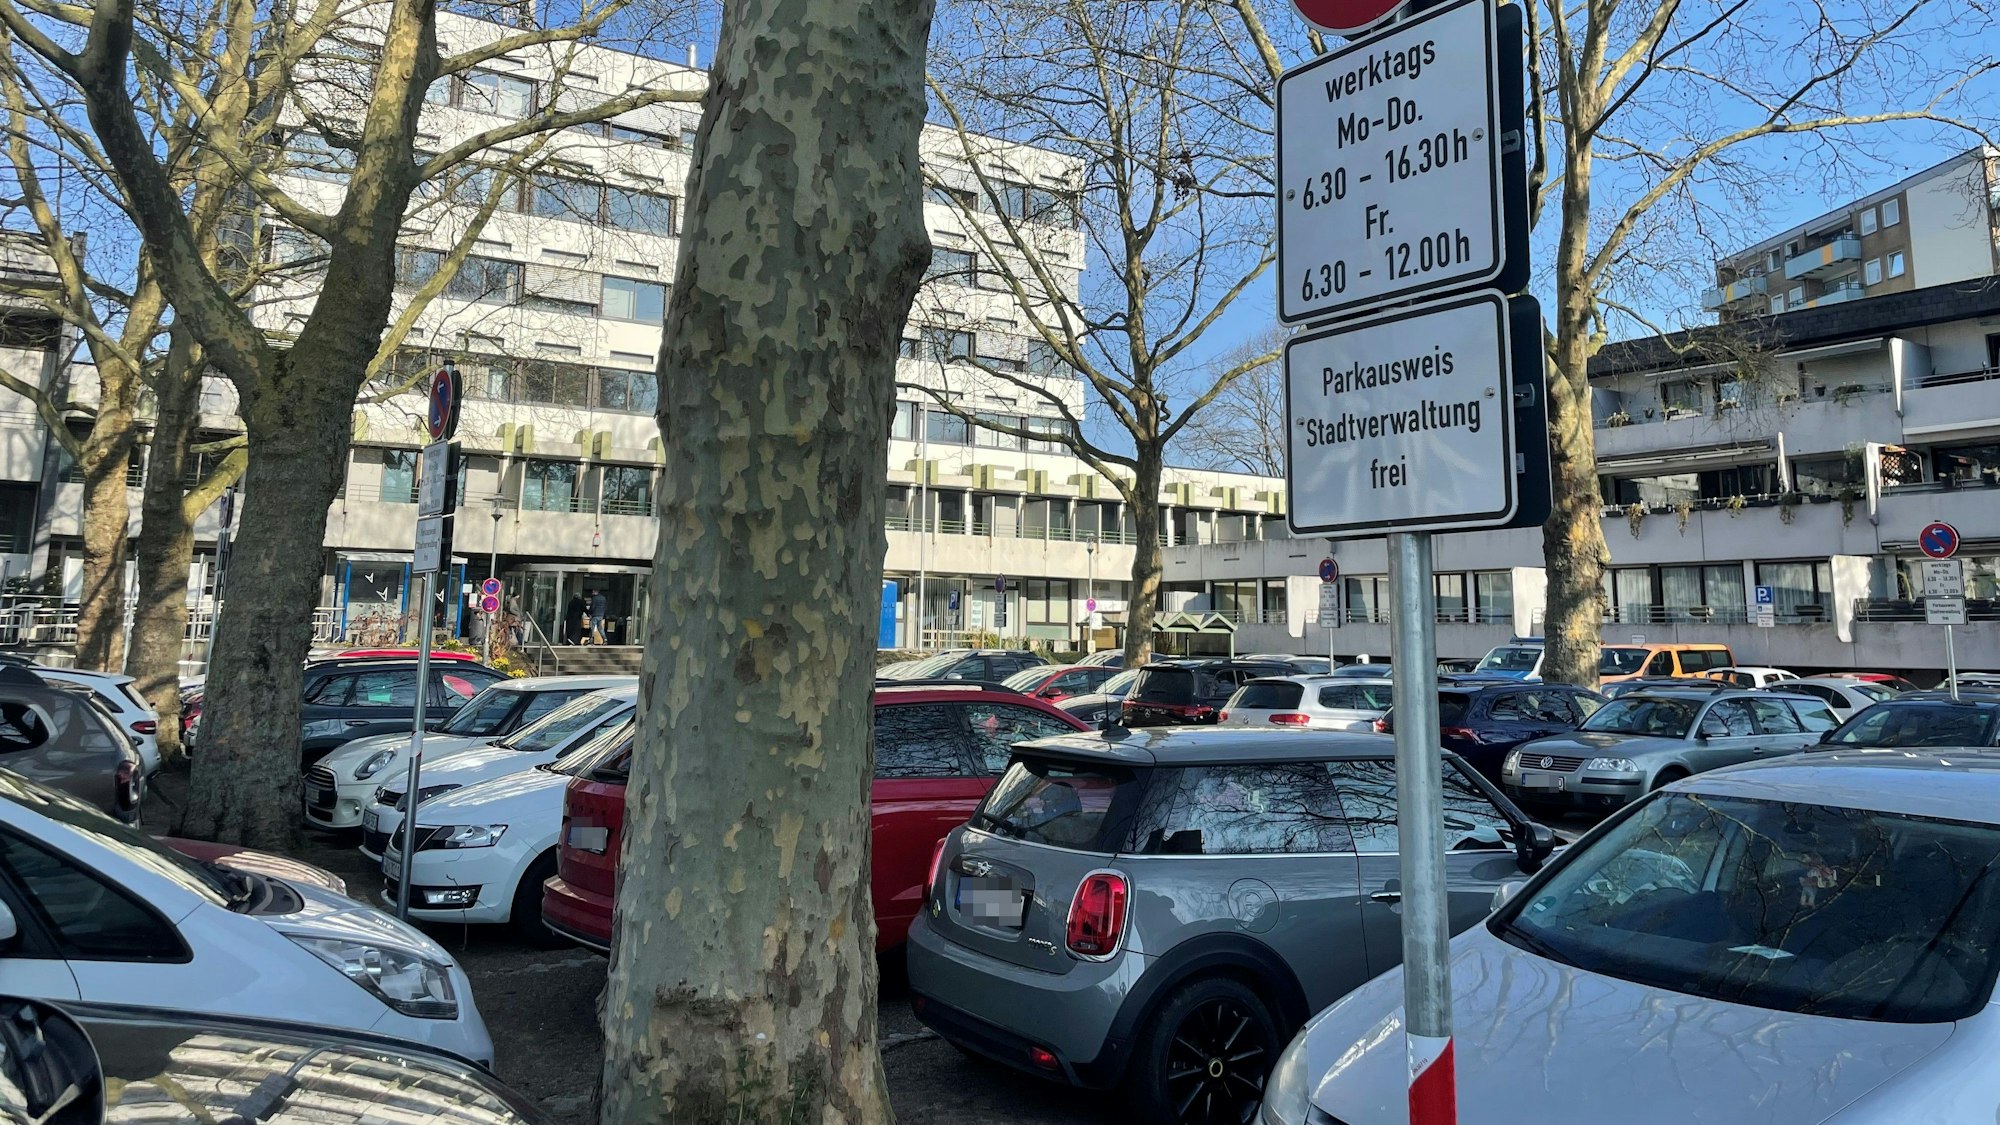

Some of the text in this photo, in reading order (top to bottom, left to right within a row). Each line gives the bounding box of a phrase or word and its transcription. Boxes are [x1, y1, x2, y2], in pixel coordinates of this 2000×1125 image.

[1325, 40, 1436, 103] werktags
[1337, 96, 1423, 149] Mo-Do.
[1303, 167, 1346, 210] 6.30
[1365, 204, 1394, 240] Fr.
[1302, 260, 1346, 302] 6.30
[1323, 345, 1454, 396] Parkausweis
[1306, 400, 1480, 447] Stadtverwaltung
[1370, 455, 1407, 489] frei
[1758, 588, 1767, 601] P
